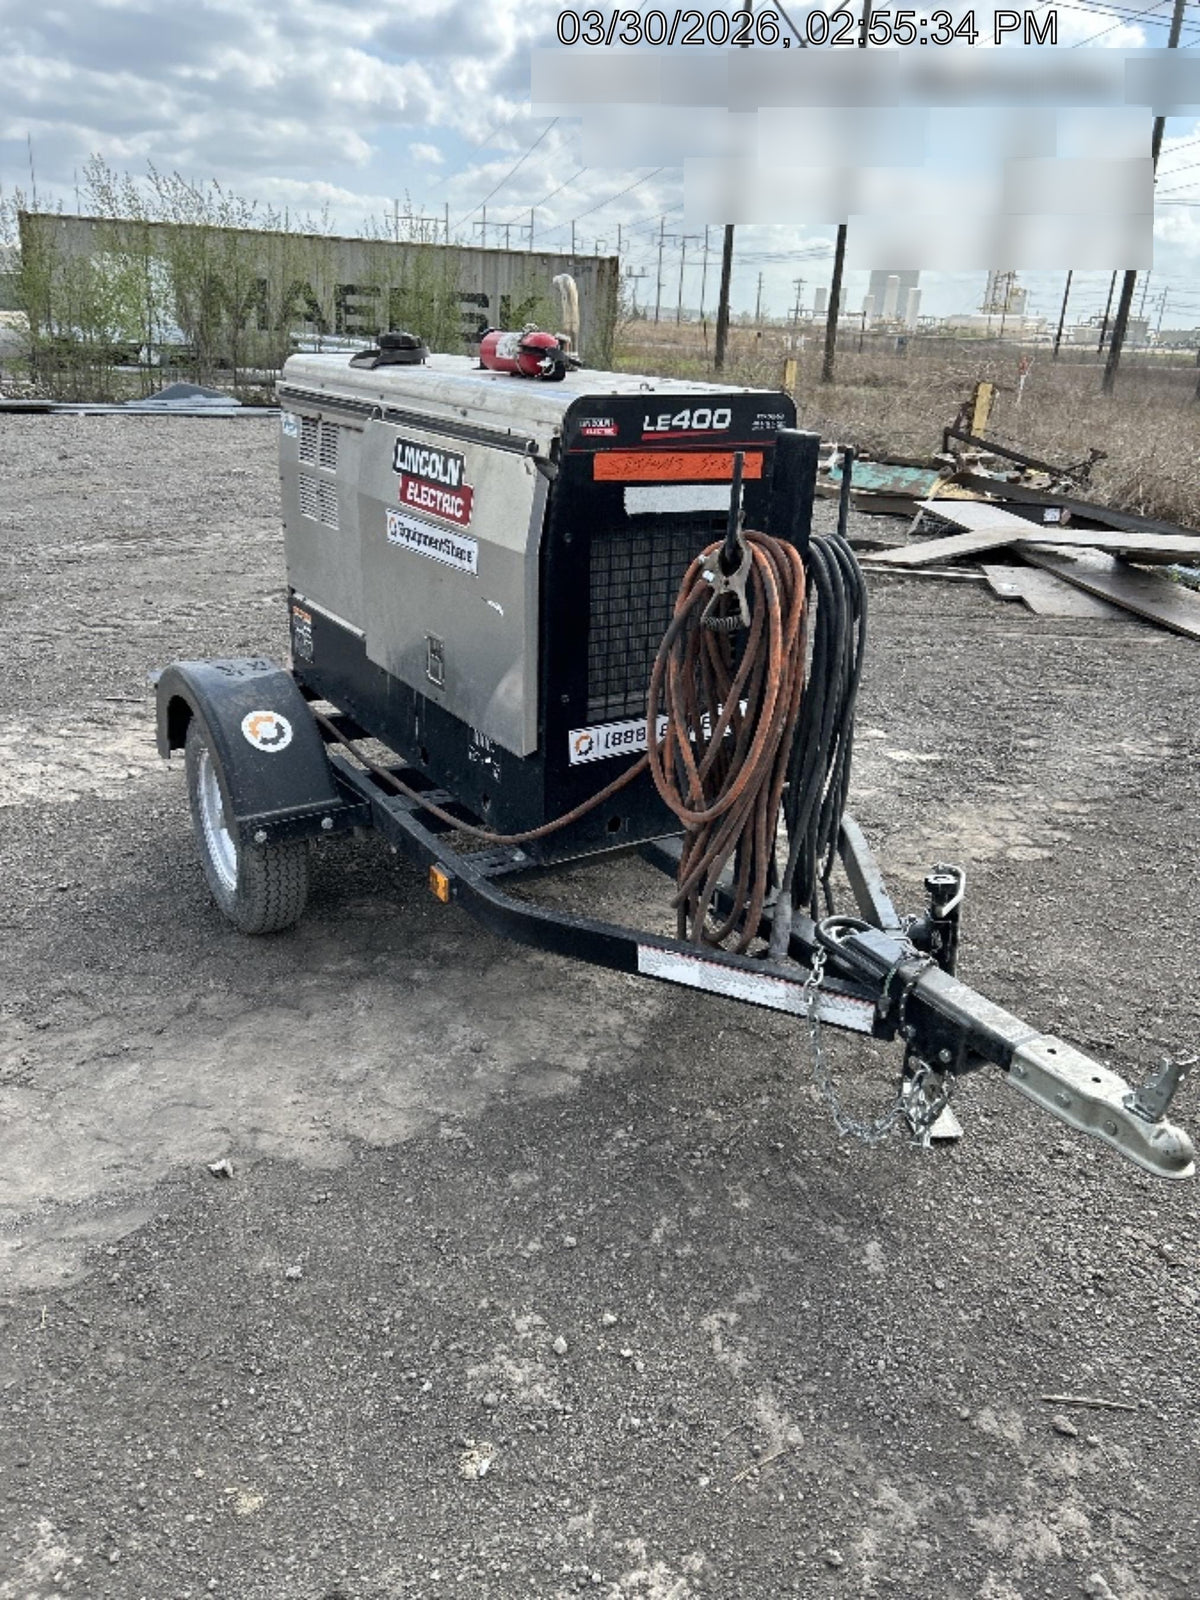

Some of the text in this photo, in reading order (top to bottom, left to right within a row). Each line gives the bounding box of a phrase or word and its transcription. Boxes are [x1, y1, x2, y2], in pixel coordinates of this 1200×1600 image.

[208, 277, 546, 343] MAESK
[642, 407, 732, 431] LE400
[395, 443, 461, 486] LINCOLN
[406, 481, 465, 518] ELECTRIC
